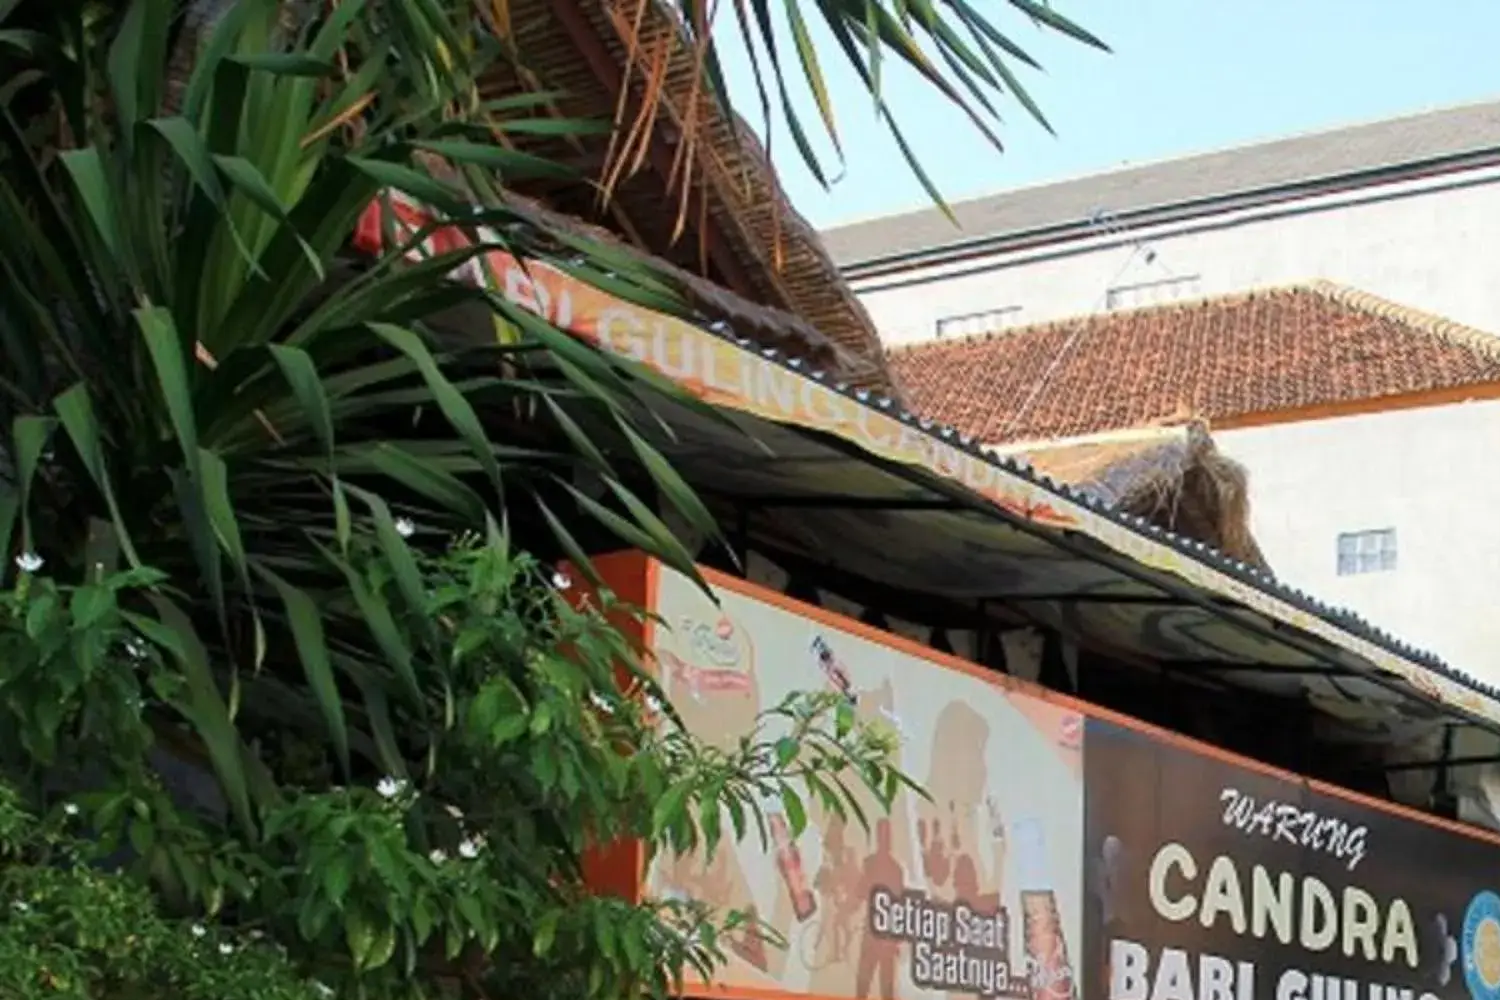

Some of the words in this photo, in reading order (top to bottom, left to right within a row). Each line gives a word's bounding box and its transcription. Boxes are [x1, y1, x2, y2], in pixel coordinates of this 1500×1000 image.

[1219, 788, 1368, 871] WARUNG
[874, 893, 949, 944] Setiap
[955, 909, 1007, 947] Saat
[1149, 842, 1420, 968] CANDRA
